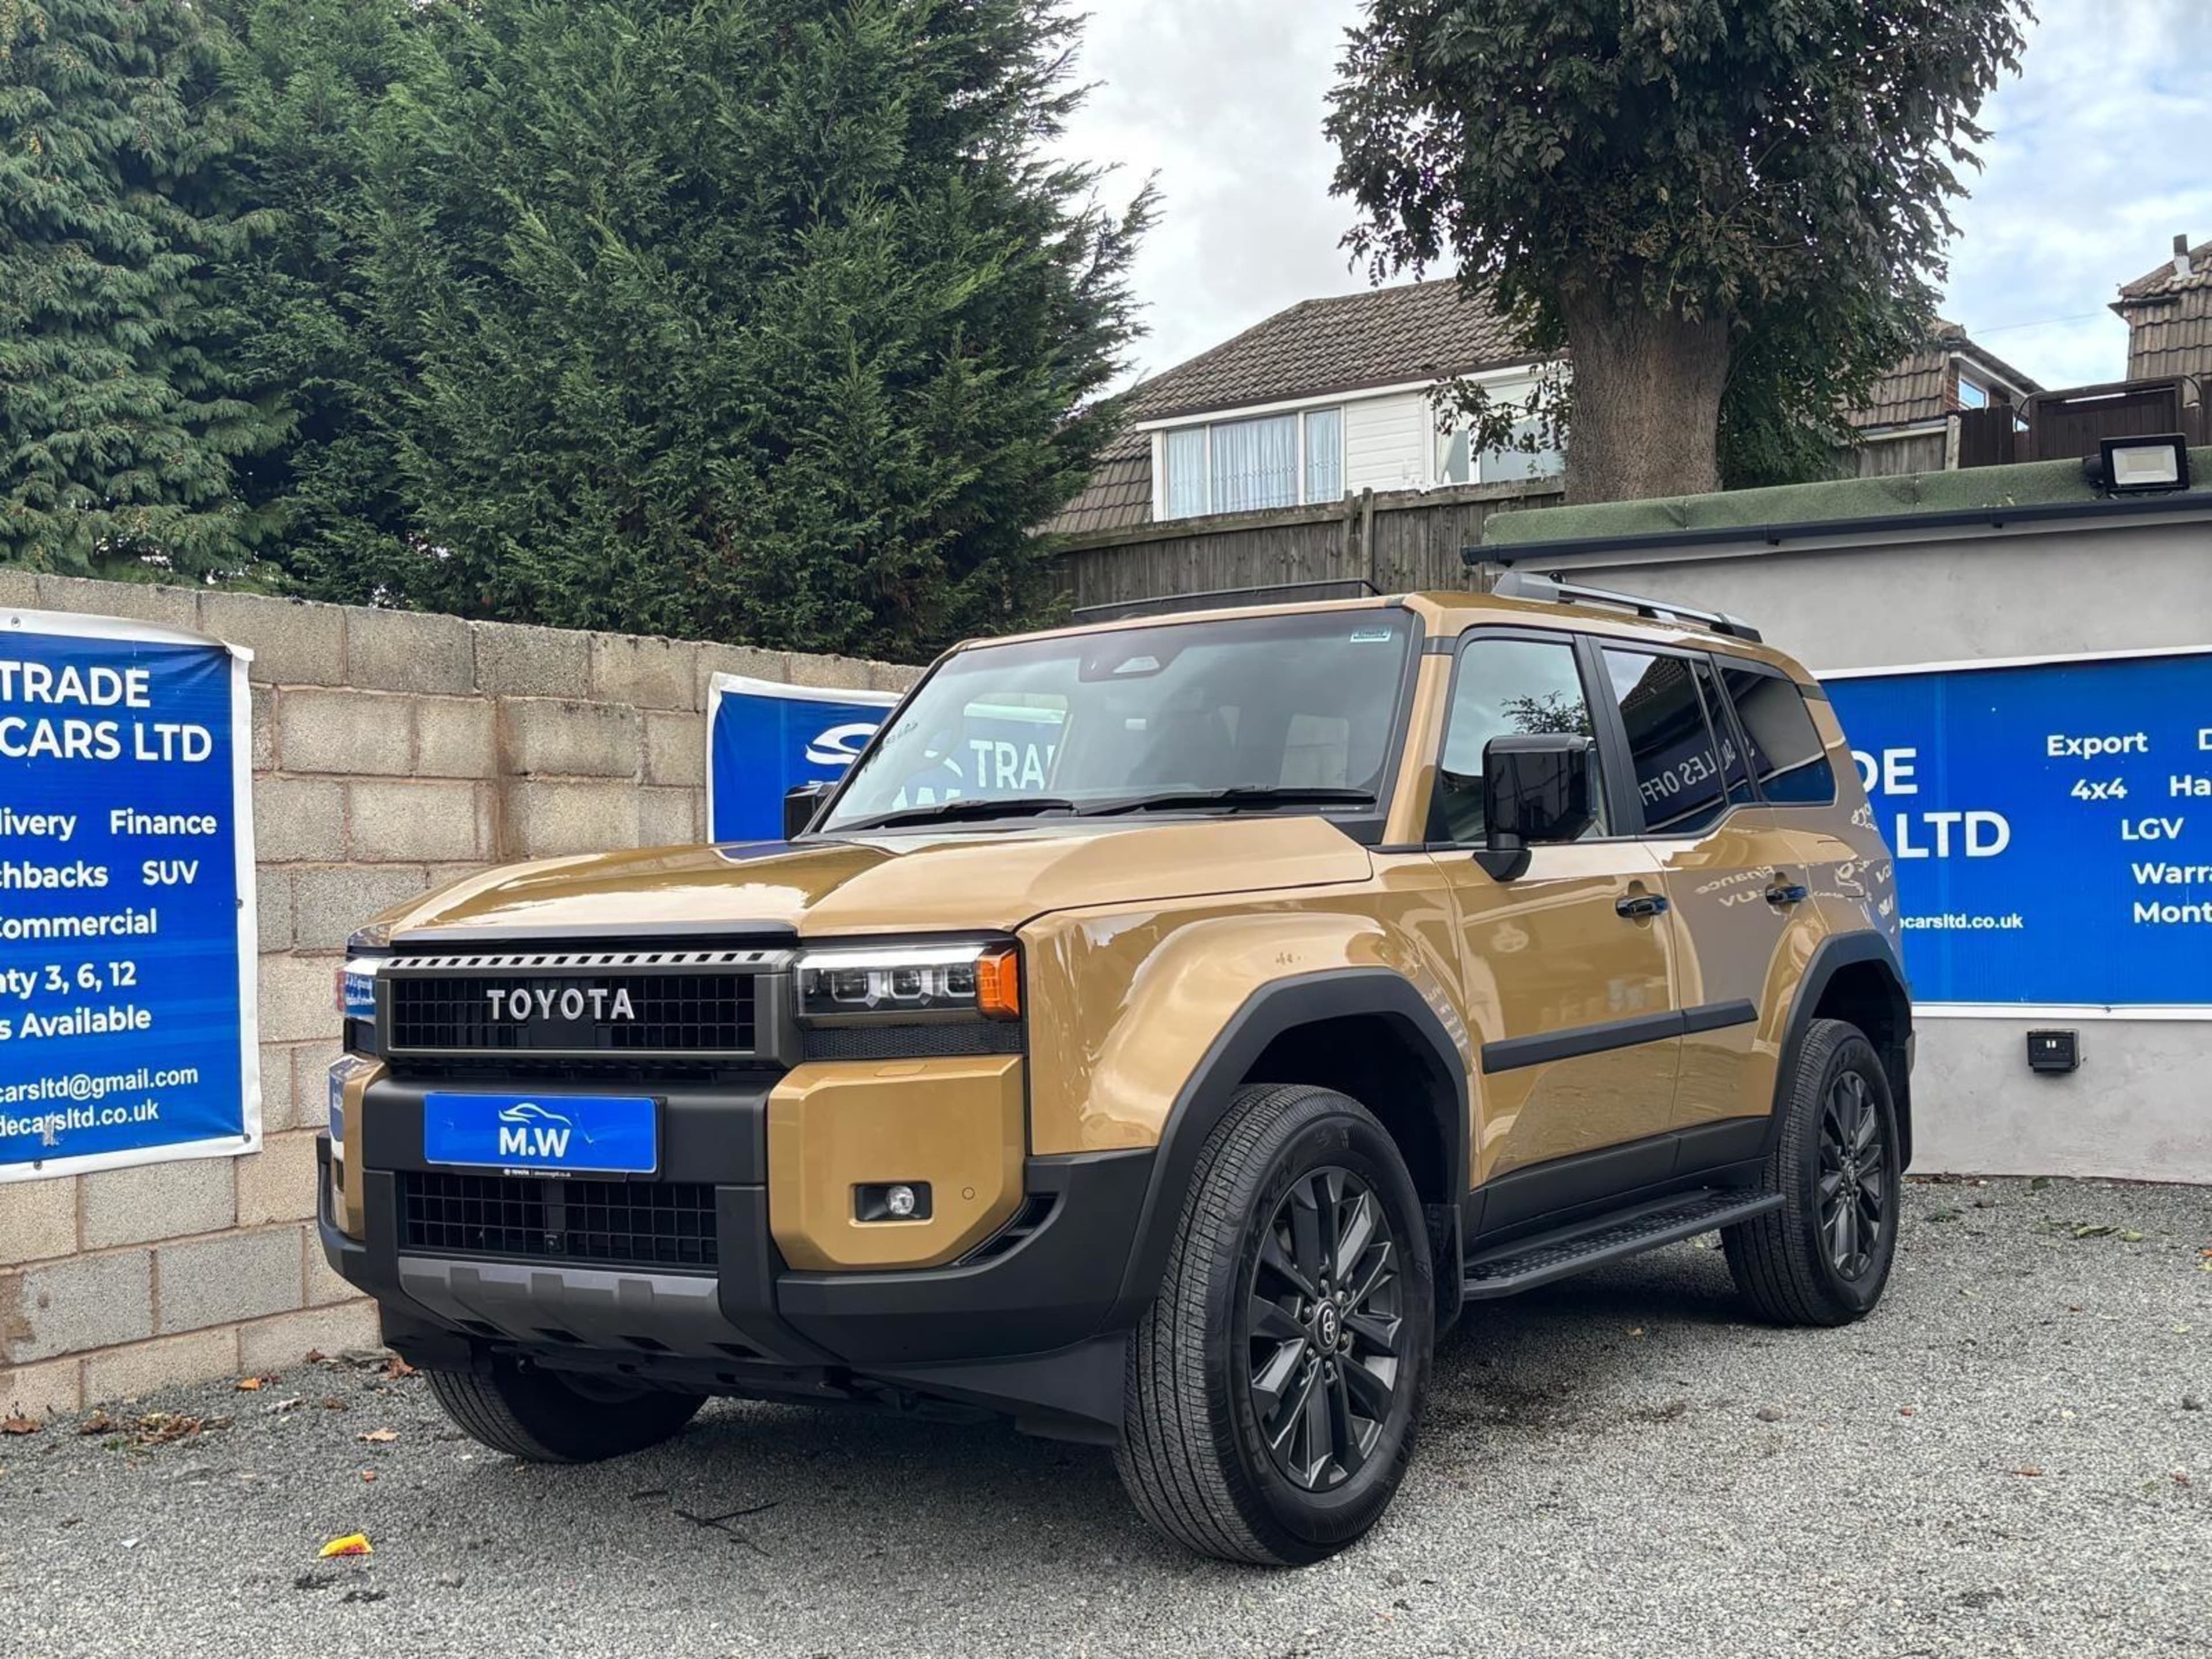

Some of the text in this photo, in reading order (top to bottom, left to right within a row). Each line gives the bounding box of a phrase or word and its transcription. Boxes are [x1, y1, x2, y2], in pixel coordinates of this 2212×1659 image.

[0, 660, 151, 708] TRADE
[0, 717, 212, 762] CARS LTD
[2047, 732, 2149, 760] Export
[969, 740, 1055, 790] TRA
[2070, 774, 2212, 800] 4x4 Ha
[110, 808, 217, 835] Finance
[1896, 810, 2010, 858] LTD
[2122, 817, 2185, 840] LGV
[0, 859, 199, 888] hbacks SUV
[2131, 862, 2212, 885] Warr
[0, 908, 157, 940] ommercial
[2134, 901, 2212, 924] Mont
[44, 964, 70, 995] 3,
[77, 963, 103, 993] 6,
[108, 961, 137, 987] 12
[486, 988, 635, 1020] TOYOTA
[19, 1005, 151, 1039] Available
[499, 1126, 570, 1158] M.W
